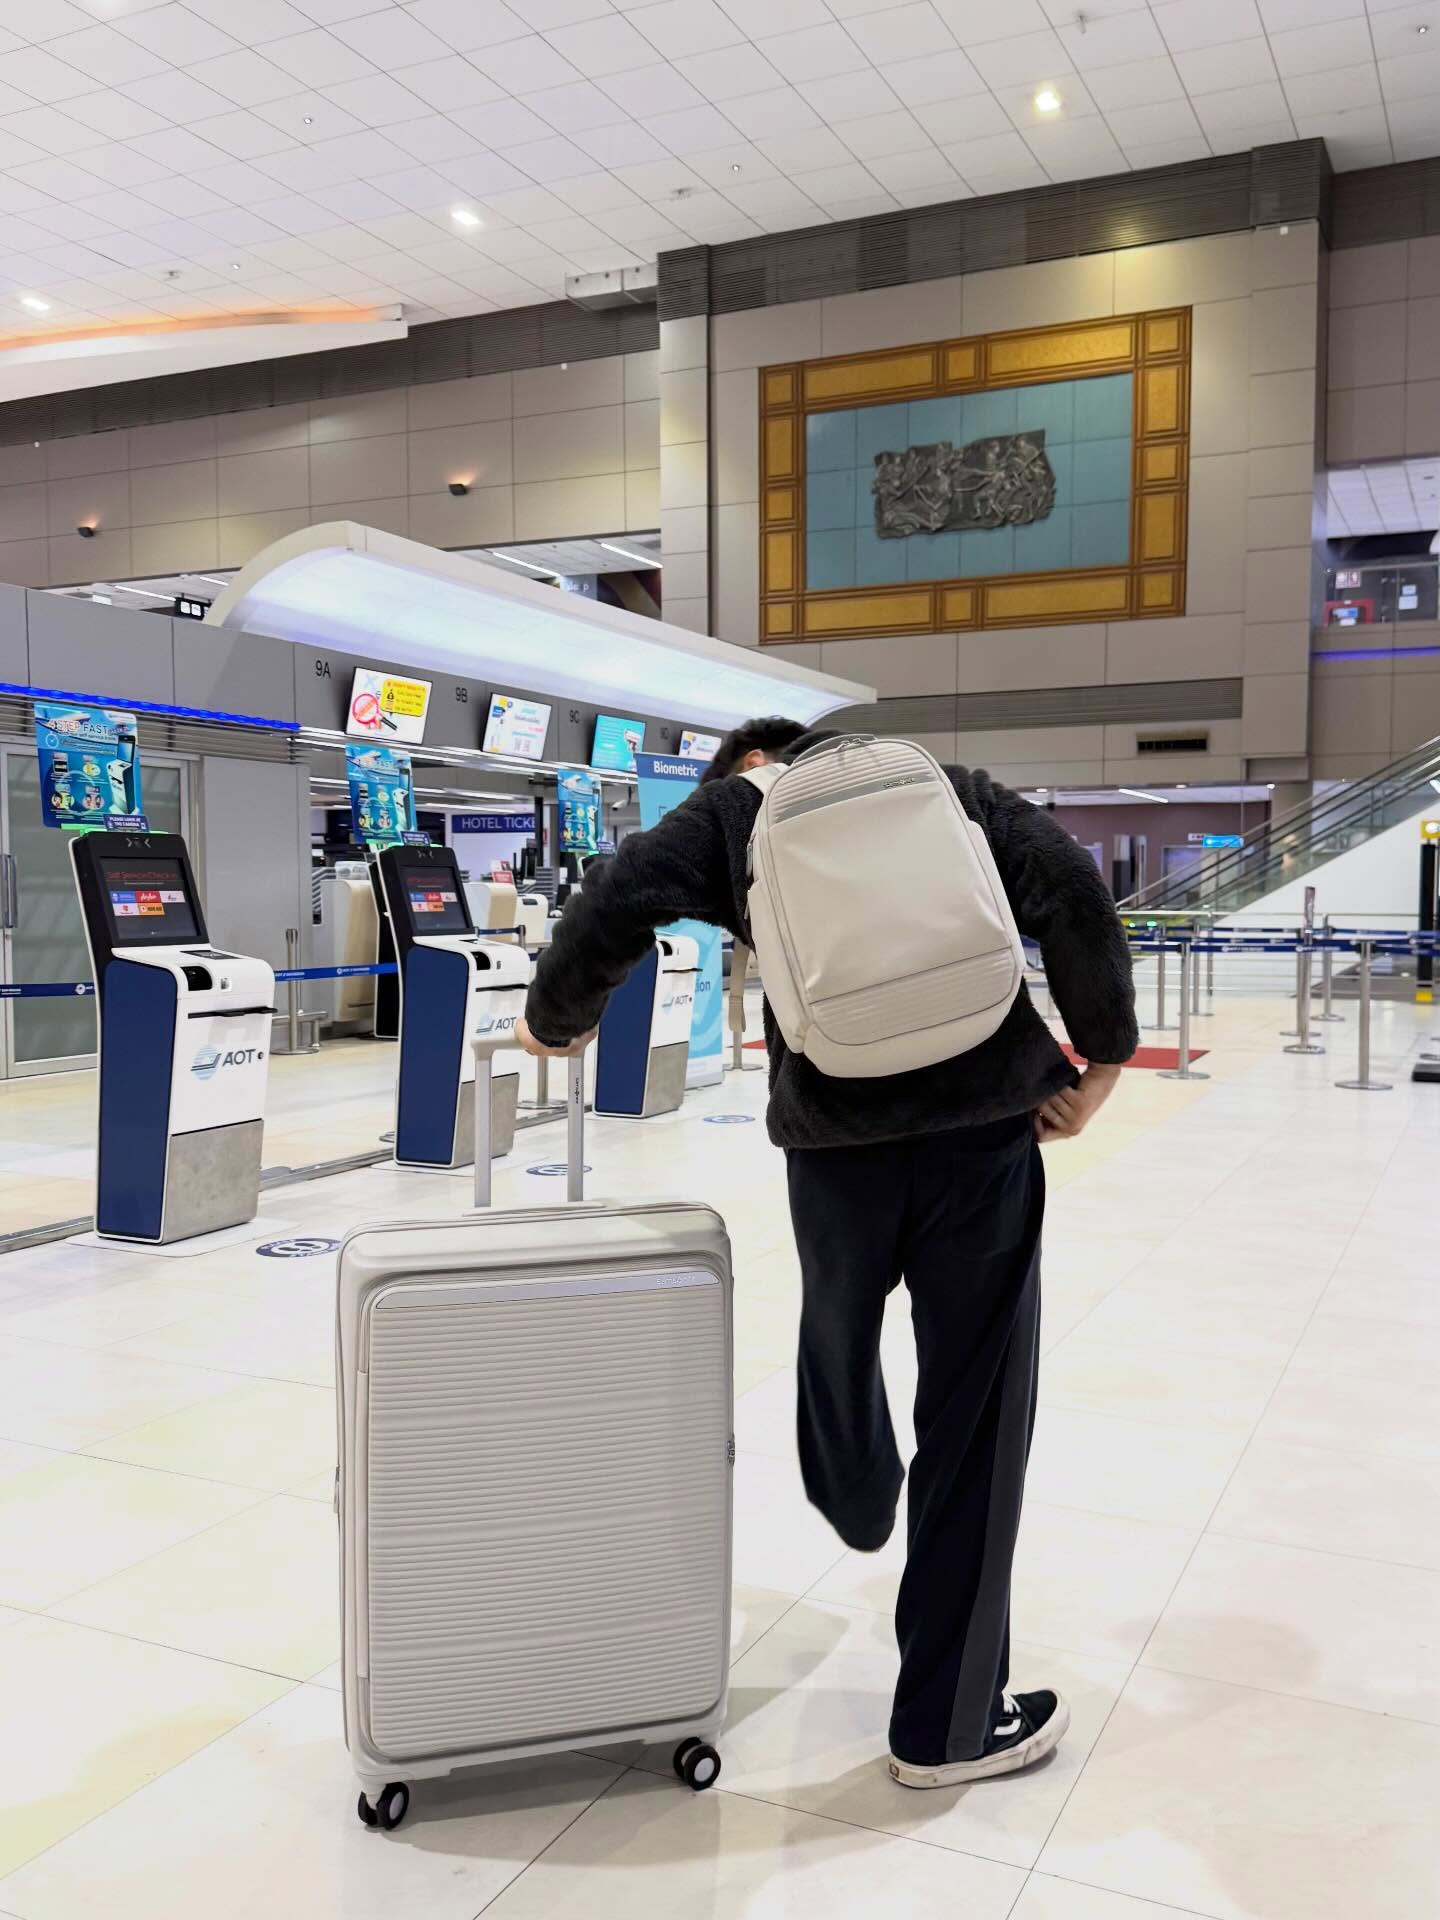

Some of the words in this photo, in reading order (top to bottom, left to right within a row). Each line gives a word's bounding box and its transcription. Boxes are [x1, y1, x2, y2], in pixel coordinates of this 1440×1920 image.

[315, 660, 331, 678] 9A
[456, 687, 468, 703] 9B
[83, 724, 107, 735] FAST
[653, 760, 699, 778] Biometric
[462, 818, 502, 829] HOTEL
[494, 1016, 517, 1031] AOT
[222, 1048, 257, 1067] AOT
